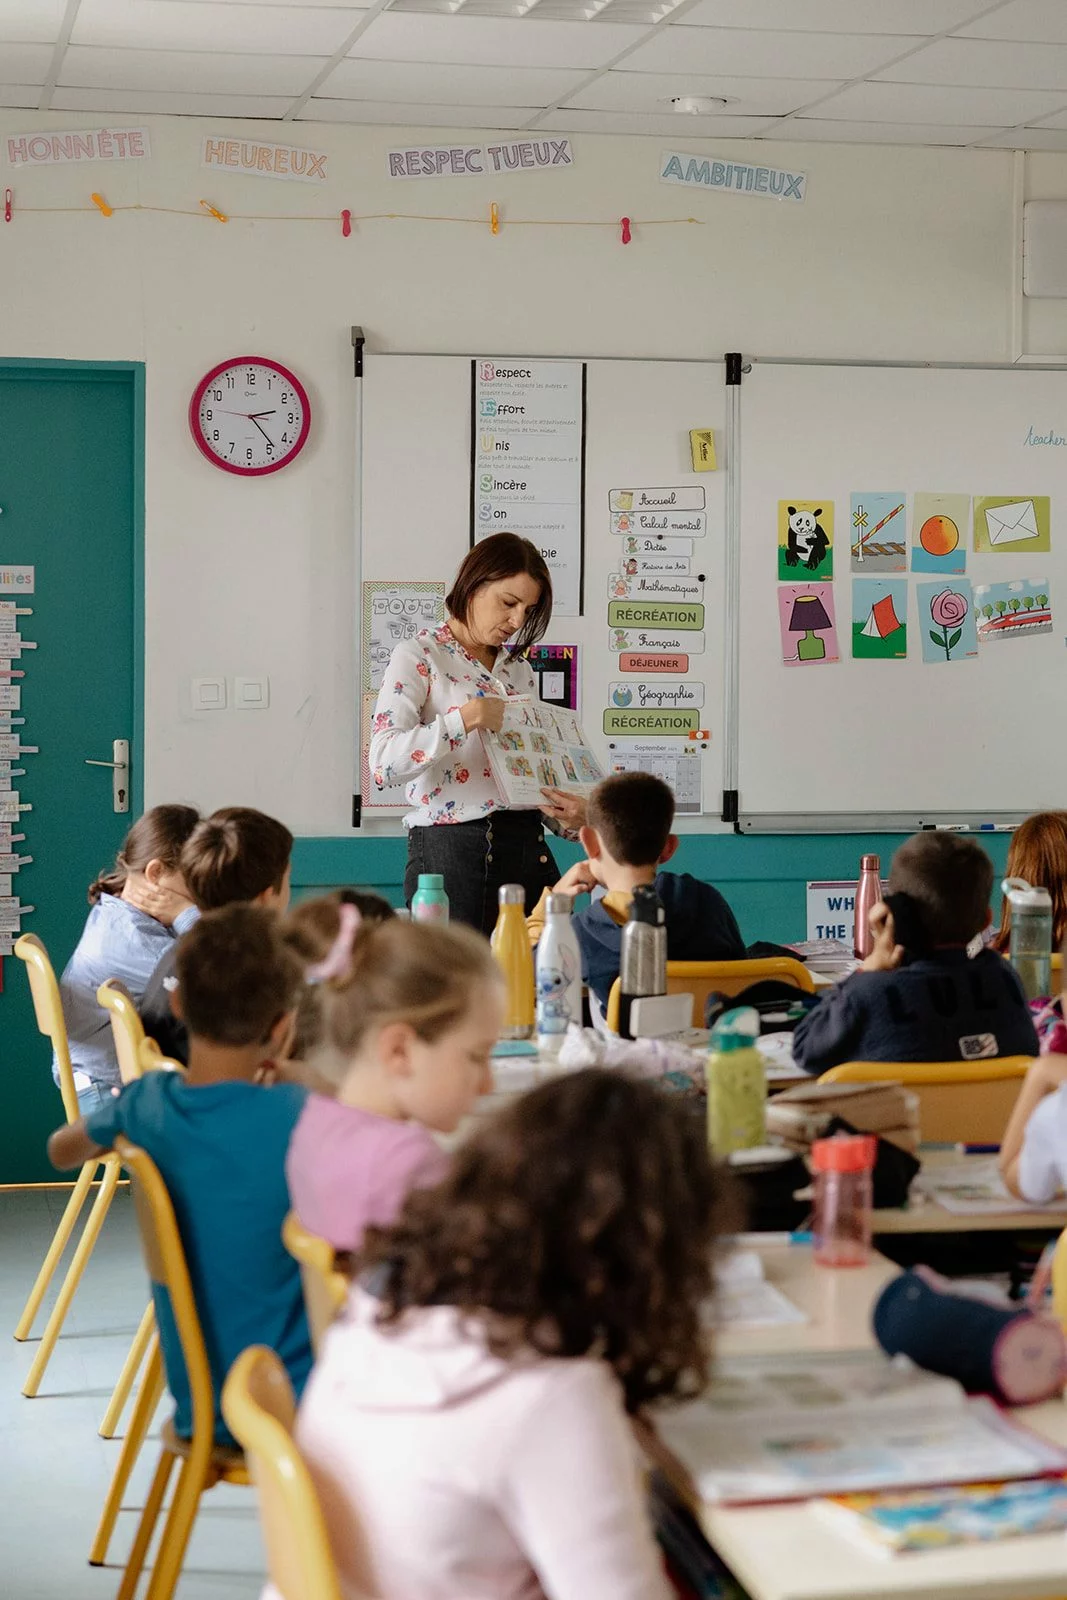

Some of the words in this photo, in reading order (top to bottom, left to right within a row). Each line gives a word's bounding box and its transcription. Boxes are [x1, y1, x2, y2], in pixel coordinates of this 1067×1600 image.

[7, 129, 145, 163] HONNÊTE
[206, 140, 327, 179] HEUREUX
[662, 155, 804, 199] AMBITIEUX
[480, 360, 531, 380] Respect
[227, 377, 234, 389] 11
[246, 373, 256, 385] 12
[267, 379, 271, 390] 1
[213, 390, 222, 401] 10
[281, 393, 287, 404] 2
[480, 398, 525, 417] Effort
[206, 410, 213, 421] 9
[287, 413, 294, 424] 3
[213, 430, 220, 441] 8
[281, 432, 287, 443] 4
[229, 442, 235, 453] 7
[266, 444, 272, 455] 5
[482, 433, 510, 453] Unis
[246, 448, 253, 459] 6
[480, 474, 526, 492] Sincère
[639, 492, 676, 505] Accueil
[479, 503, 507, 521] Son
[640, 516, 668, 529] Calcul
[671, 518, 701, 530] mental
[644, 540, 667, 551] Dictée
[637, 579, 699, 598] Mathématiques
[616, 608, 696, 622] RÉCRÉATION
[638, 634, 681, 649] Français
[541, 647, 573, 659] BEEN
[630, 658, 679, 668] DÉJEUNER
[638, 685, 694, 706] Géographie
[611, 715, 692, 728] RÉCRÉATION
[816, 925, 846, 939] THE
